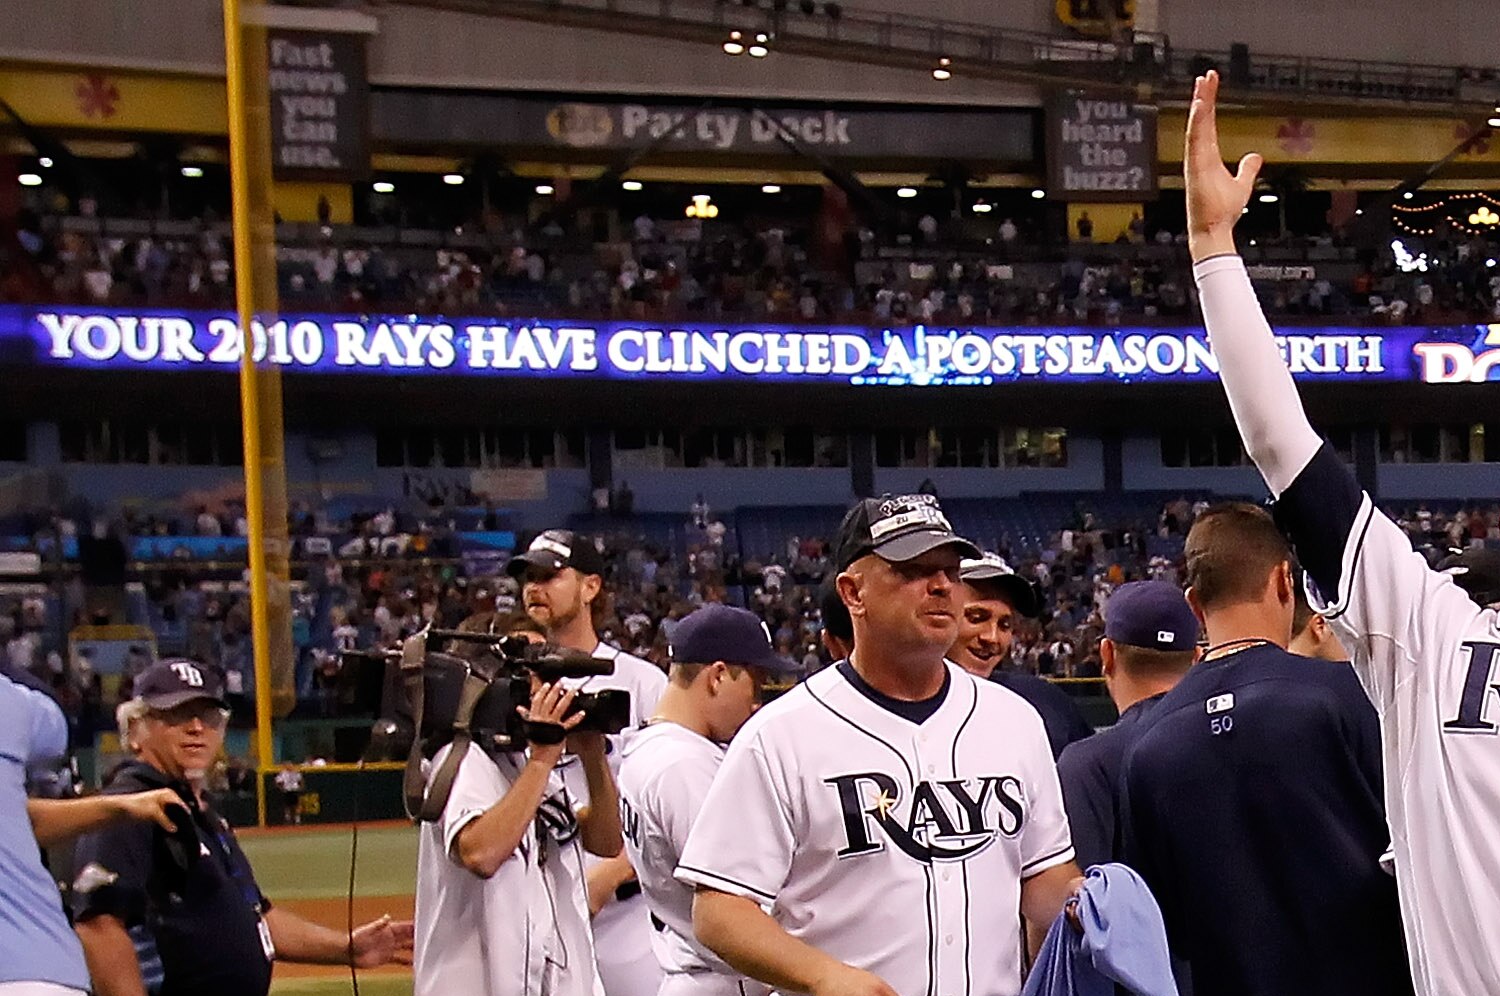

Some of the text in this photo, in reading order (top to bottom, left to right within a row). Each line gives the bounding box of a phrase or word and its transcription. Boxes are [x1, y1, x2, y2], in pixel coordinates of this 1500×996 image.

[1076, 100, 1128, 124] you
[1062, 119, 1142, 142] heard
[1080, 143, 1127, 166] the
[1063, 166, 1144, 190] buzz?
[37, 312, 205, 362] YOUR
[209, 318, 324, 366] 2010
[333, 321, 456, 368] RAYS
[466, 326, 598, 371] HAVE
[607, 330, 872, 376] CLINCHED
[876, 334, 915, 375] A
[924, 334, 1218, 375] POSTSEASON
[1211, 715, 1233, 735] 50
[822, 772, 1025, 866] RAYS
